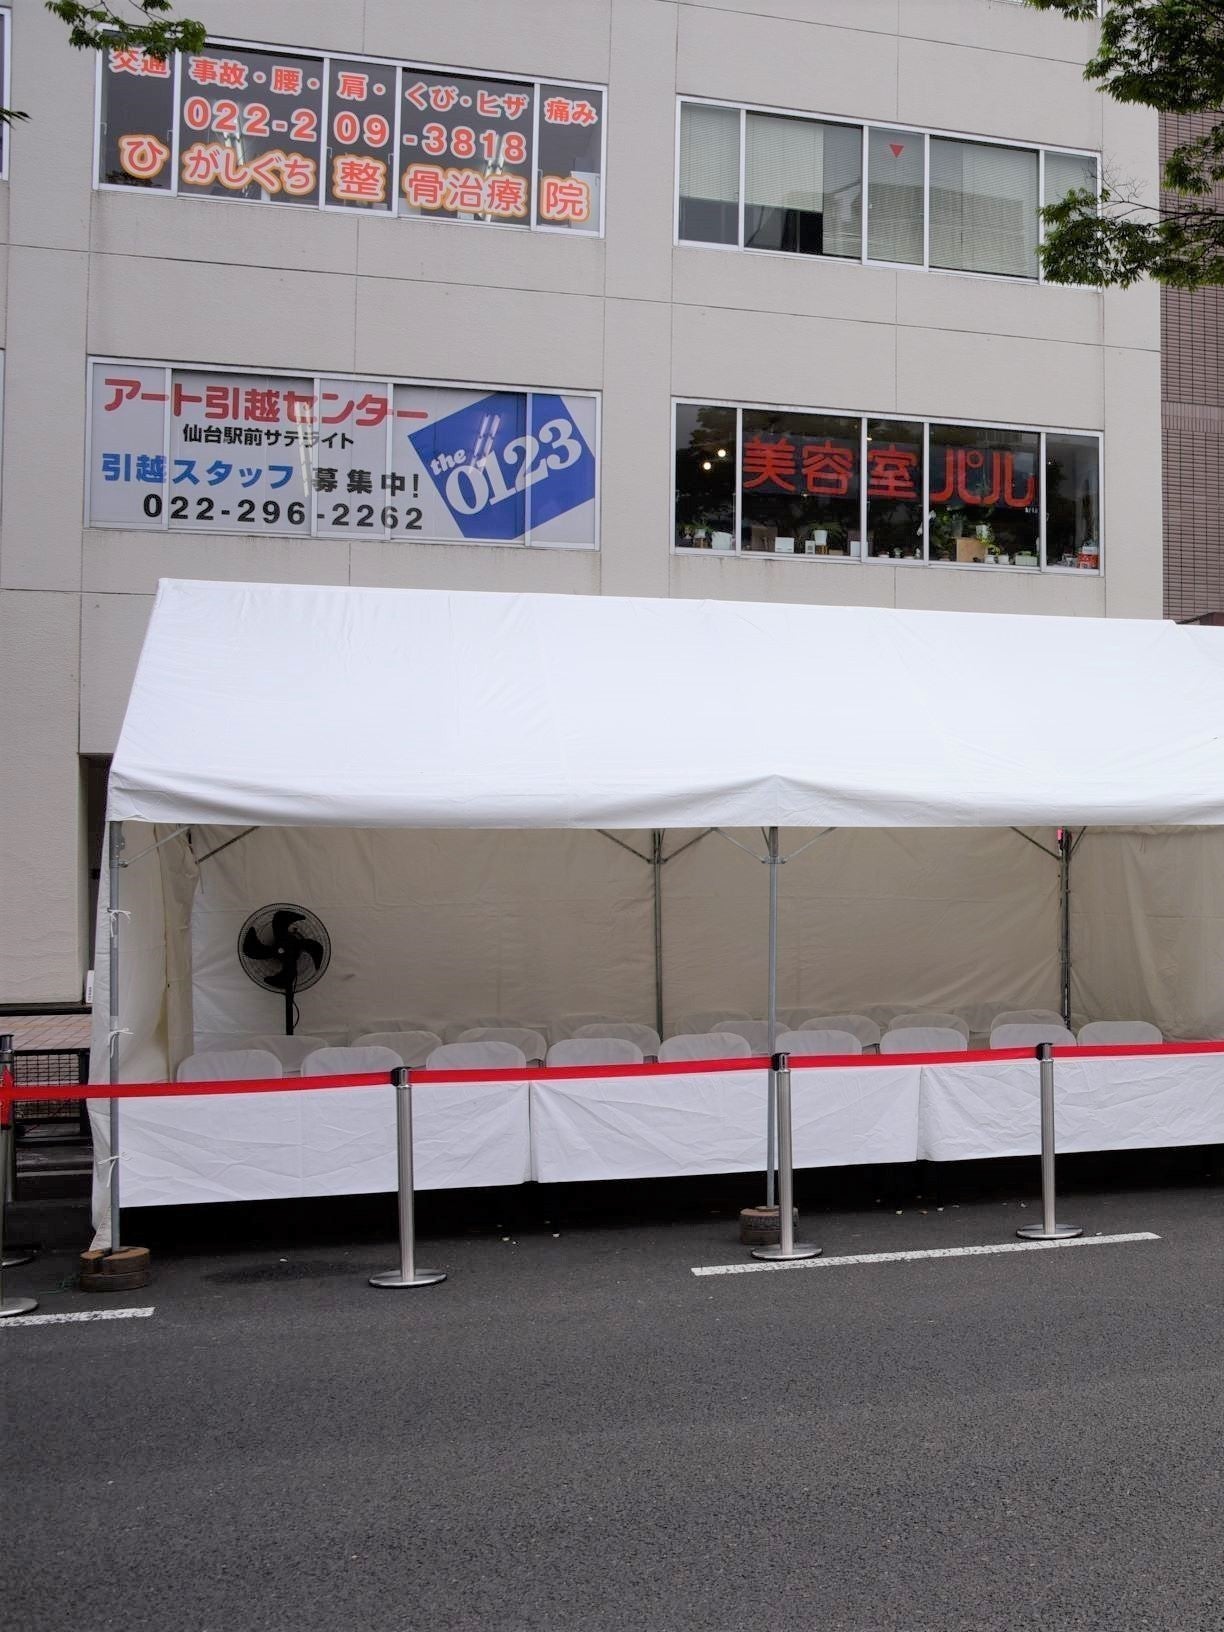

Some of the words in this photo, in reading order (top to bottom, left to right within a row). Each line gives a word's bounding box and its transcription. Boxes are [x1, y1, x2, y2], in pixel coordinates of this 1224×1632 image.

[185, 97, 527, 164] 022-209-3818
[104, 378, 429, 427] アート引越センター
[183, 423, 354, 450] 仙台駅前サテライト
[102, 453, 293, 489] 引越スタッフ
[429, 449, 467, 476] the
[445, 418, 583, 515] 0123
[143, 494, 423, 530] 022-296-2262
